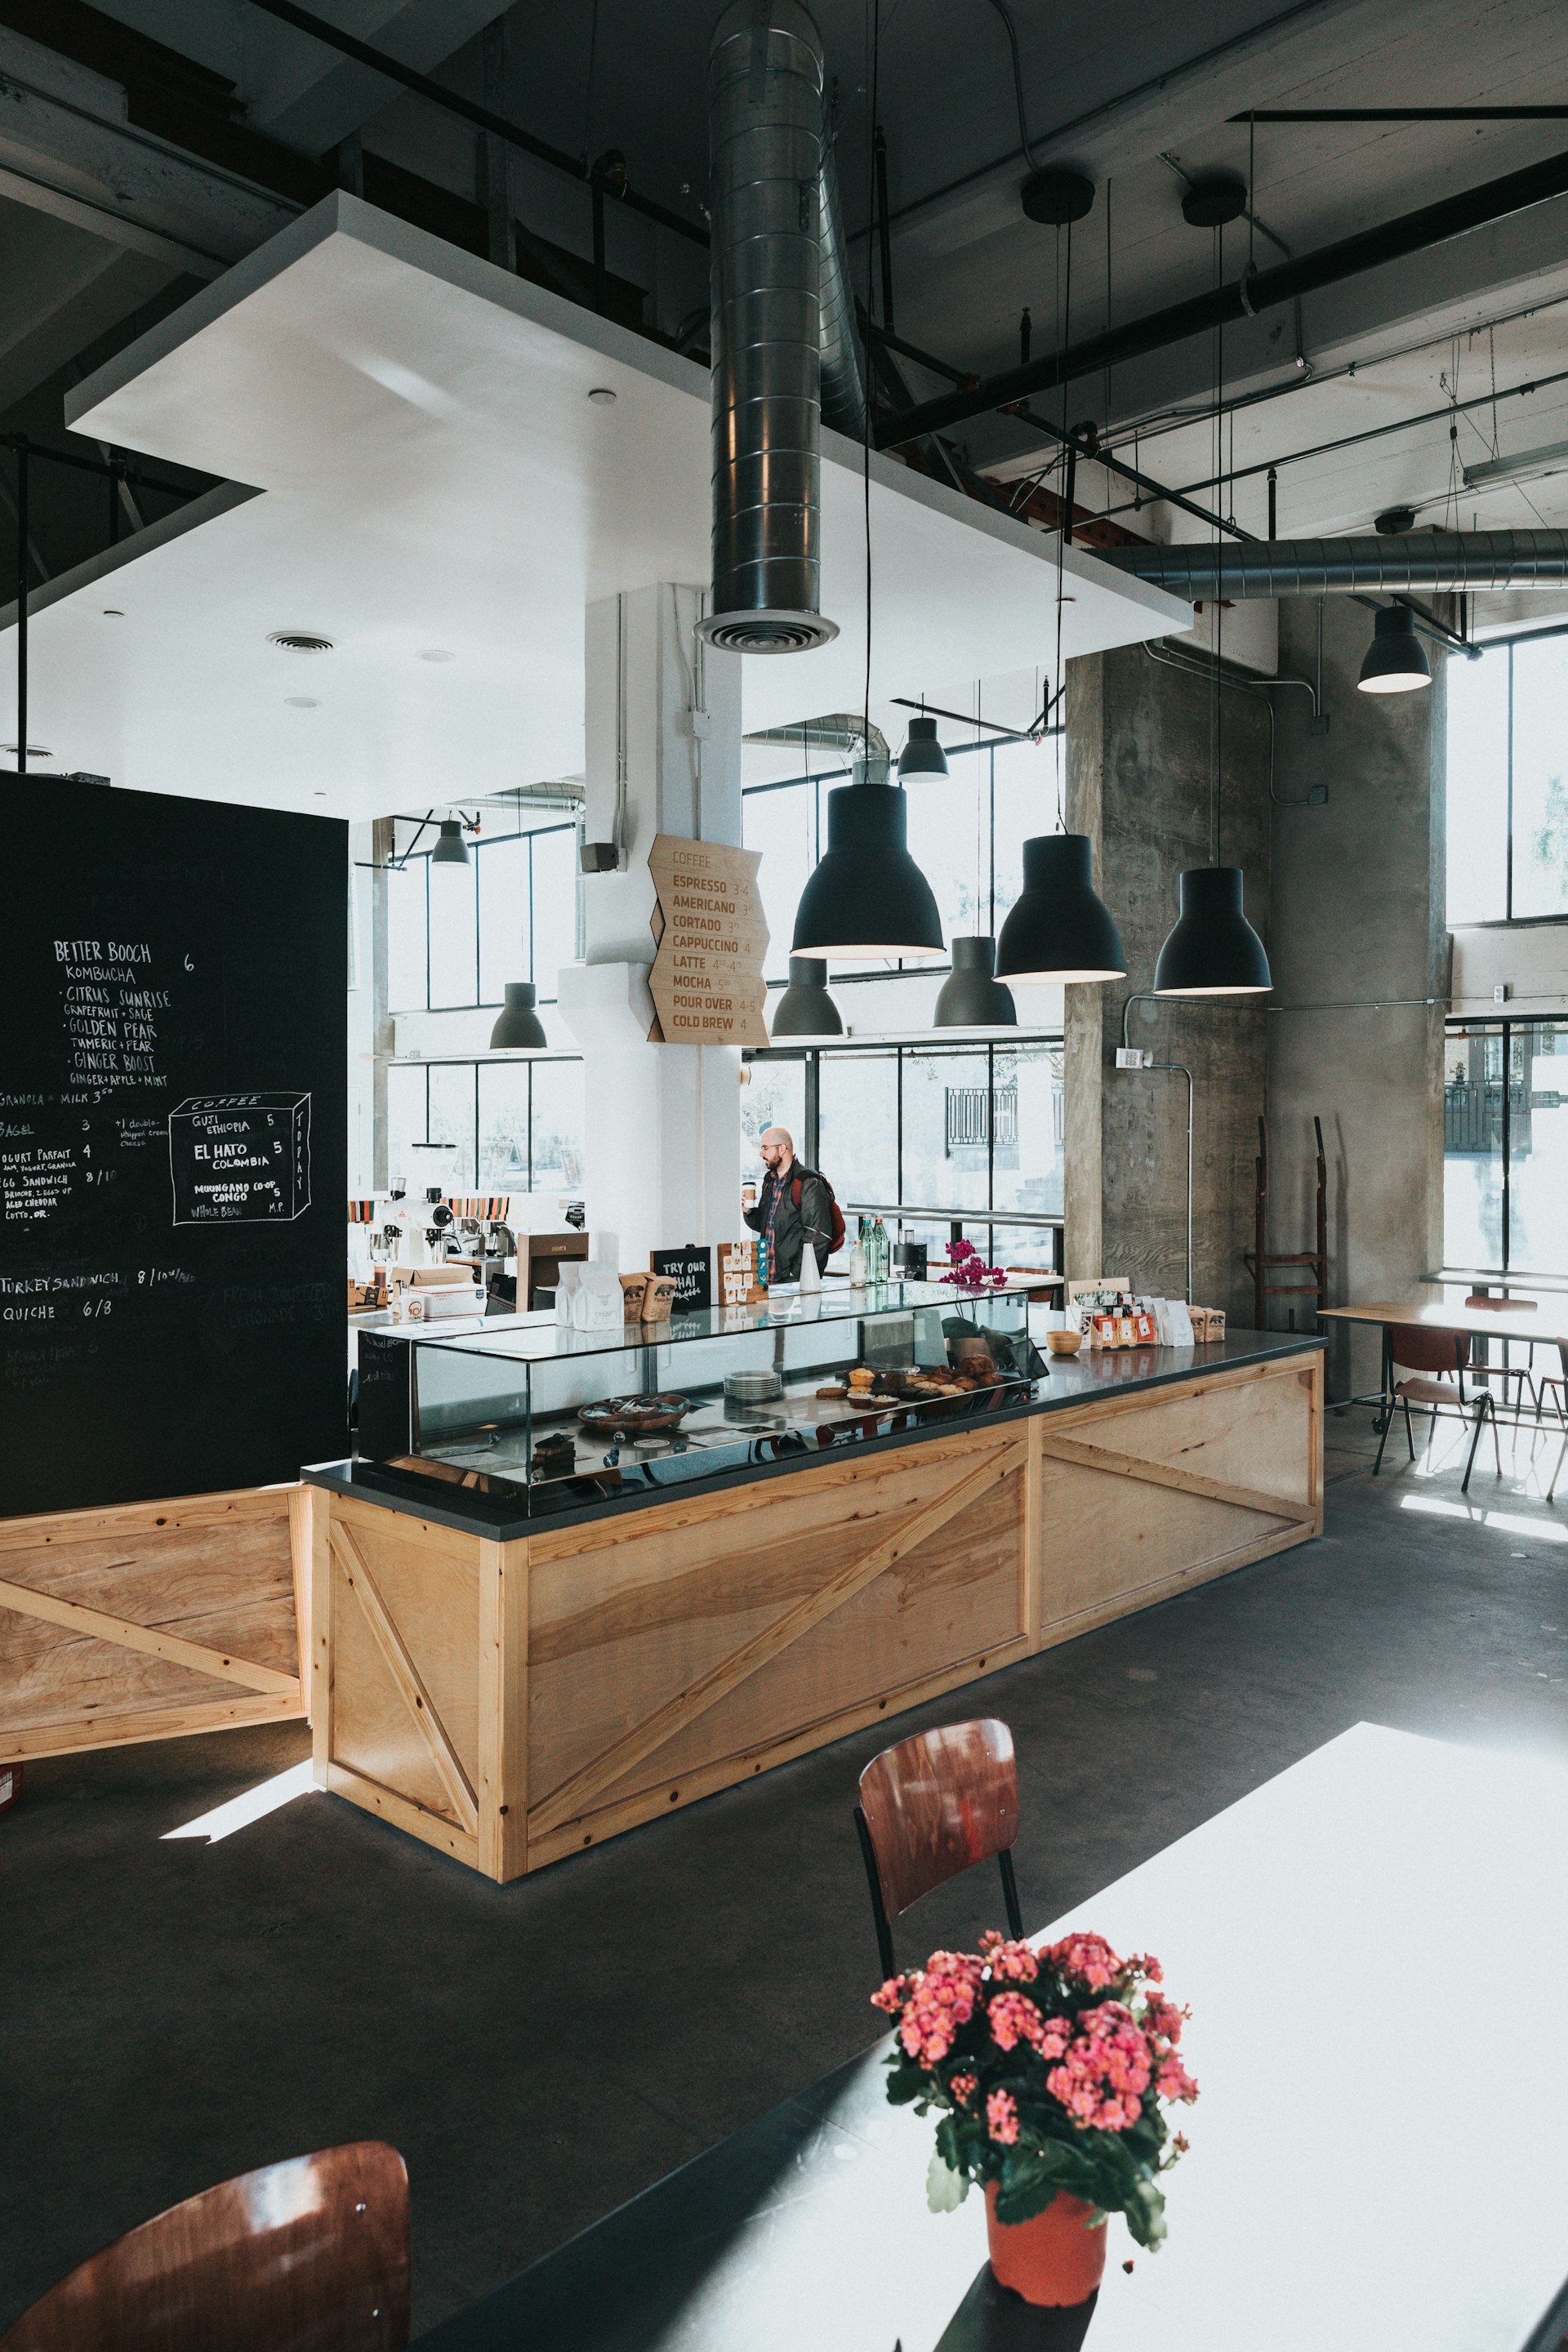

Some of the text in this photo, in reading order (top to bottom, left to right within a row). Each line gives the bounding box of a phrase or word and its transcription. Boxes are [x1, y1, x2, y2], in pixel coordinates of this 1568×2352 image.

[673, 851, 711, 868] COFFEE
[673, 875, 749, 897] ESPRESSO 3-4
[673, 894, 735, 914] AMERICANO
[673, 915, 721, 931] CORTADO
[673, 934, 751, 955] CAPPUCCINO 4
[54, 941, 194, 972] BETTER BOOCH 6
[673, 955, 706, 969] LATTE
[65, 965, 136, 984] KOMBUCHA
[673, 974, 711, 989] MOCHA
[66, 986, 172, 1009] CITRUS SUNRISE
[673, 995, 755, 1013] POUR OVER 4-5
[64, 1004, 119, 1018] GRAPEFRUIT
[129, 1008, 154, 1022] SAGE
[69, 1018, 158, 1040] GOLDEN PEAR
[673, 1014, 747, 1030] COLD BREW 4
[70, 1038, 117, 1050] TUMERIC
[126, 1040, 154, 1053] PEAR
[74, 1052, 154, 1072] GINGER BOOST
[144, 1076, 167, 1087] MINT
[60, 1093, 88, 1104] MILK
[192, 1096, 261, 1110] COFFEE
[82, 1120, 91, 1131] 3
[192, 1114, 274, 1127] GUJI 5
[207, 1121, 250, 1134] ETHIOPIA
[2, 1152, 32, 1164] OGURT
[82, 1144, 91, 1158] 4
[194, 1141, 283, 1160] EL HATO 5
[212, 1156, 270, 1170] COLOMBIA
[253, 1181, 275, 1191] CO-OP
[212, 1188, 281, 1202] CONGO 5
[6, 1198, 57, 1209] AGED CHEDDAR
[220, 1206, 243, 1218] BEAN
[662, 1261, 706, 1275] TRY OUR
[3, 1305, 56, 1321] QUICHE
